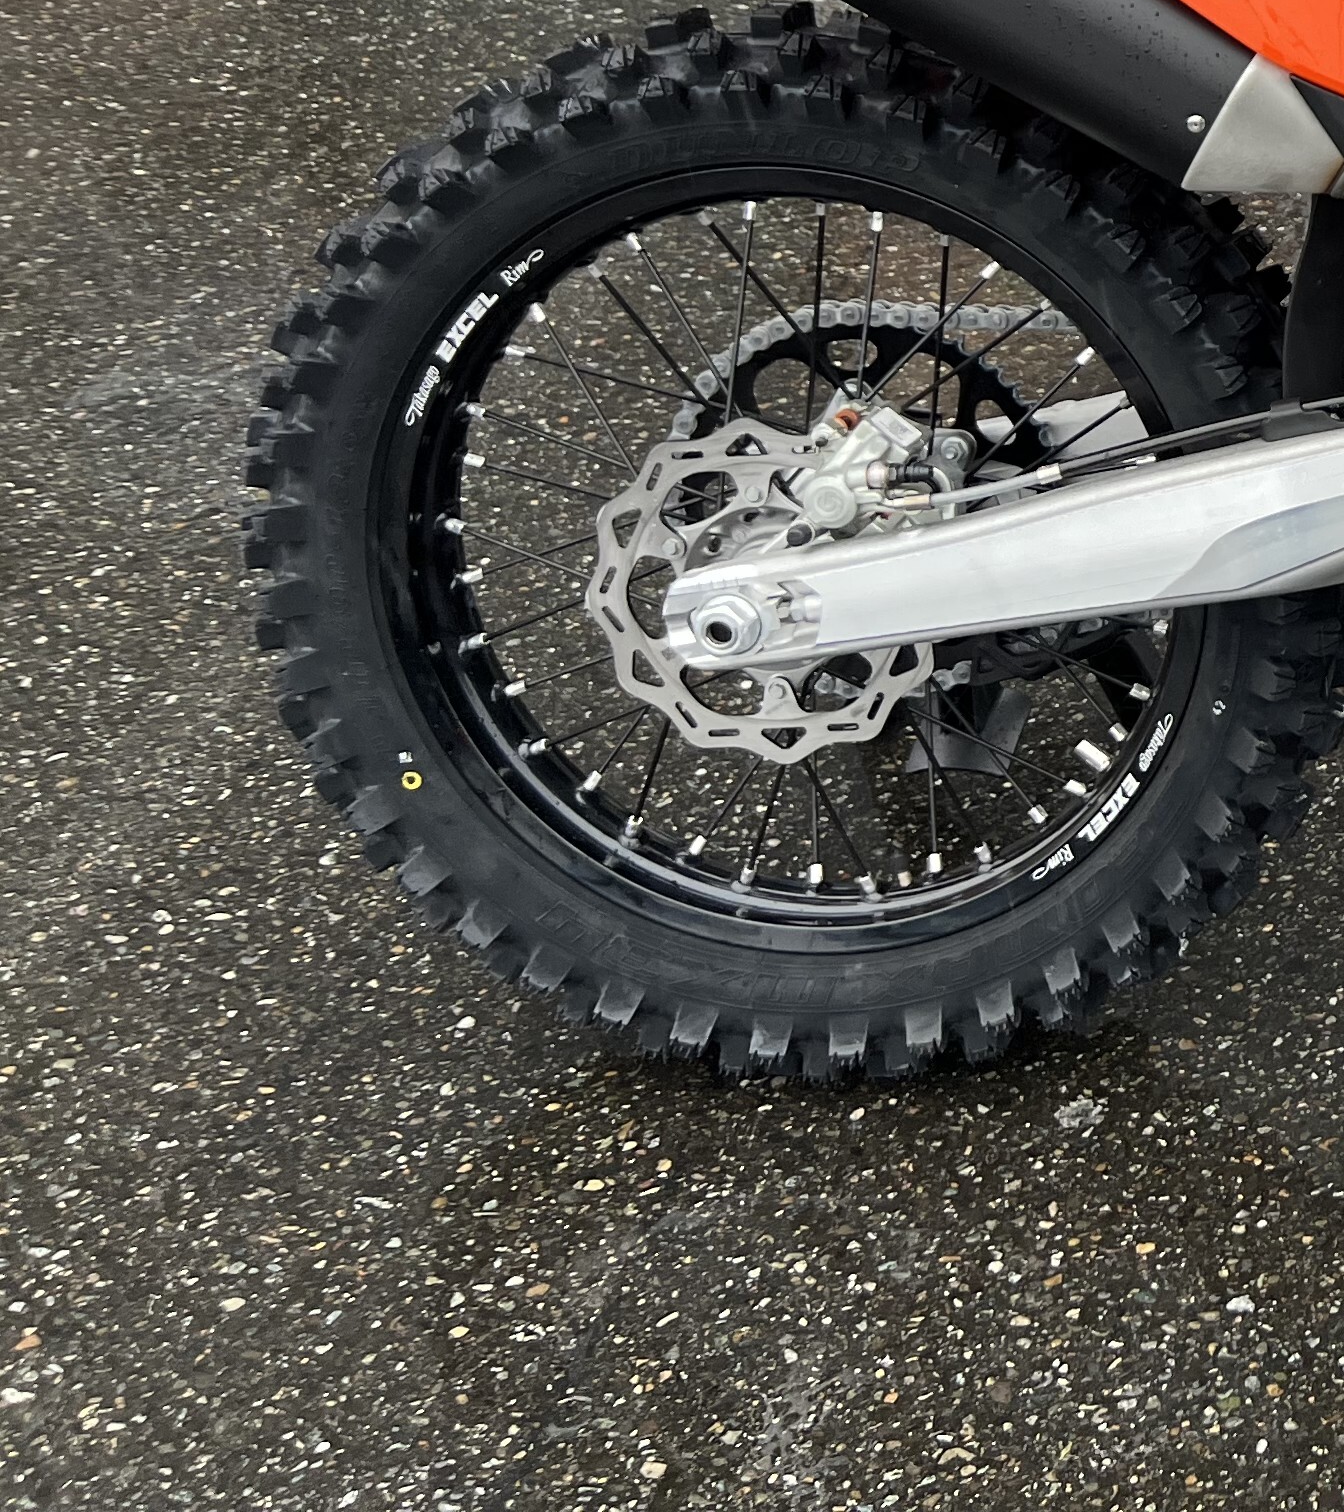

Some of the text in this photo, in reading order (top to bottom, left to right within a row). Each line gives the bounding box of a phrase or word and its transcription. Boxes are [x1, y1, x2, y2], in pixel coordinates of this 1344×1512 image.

[434, 291, 499, 363] EXCEL
[500, 248, 545, 287] Rim
[1075, 772, 1141, 842] EXCEL
[1031, 843, 1075, 882] Rim
